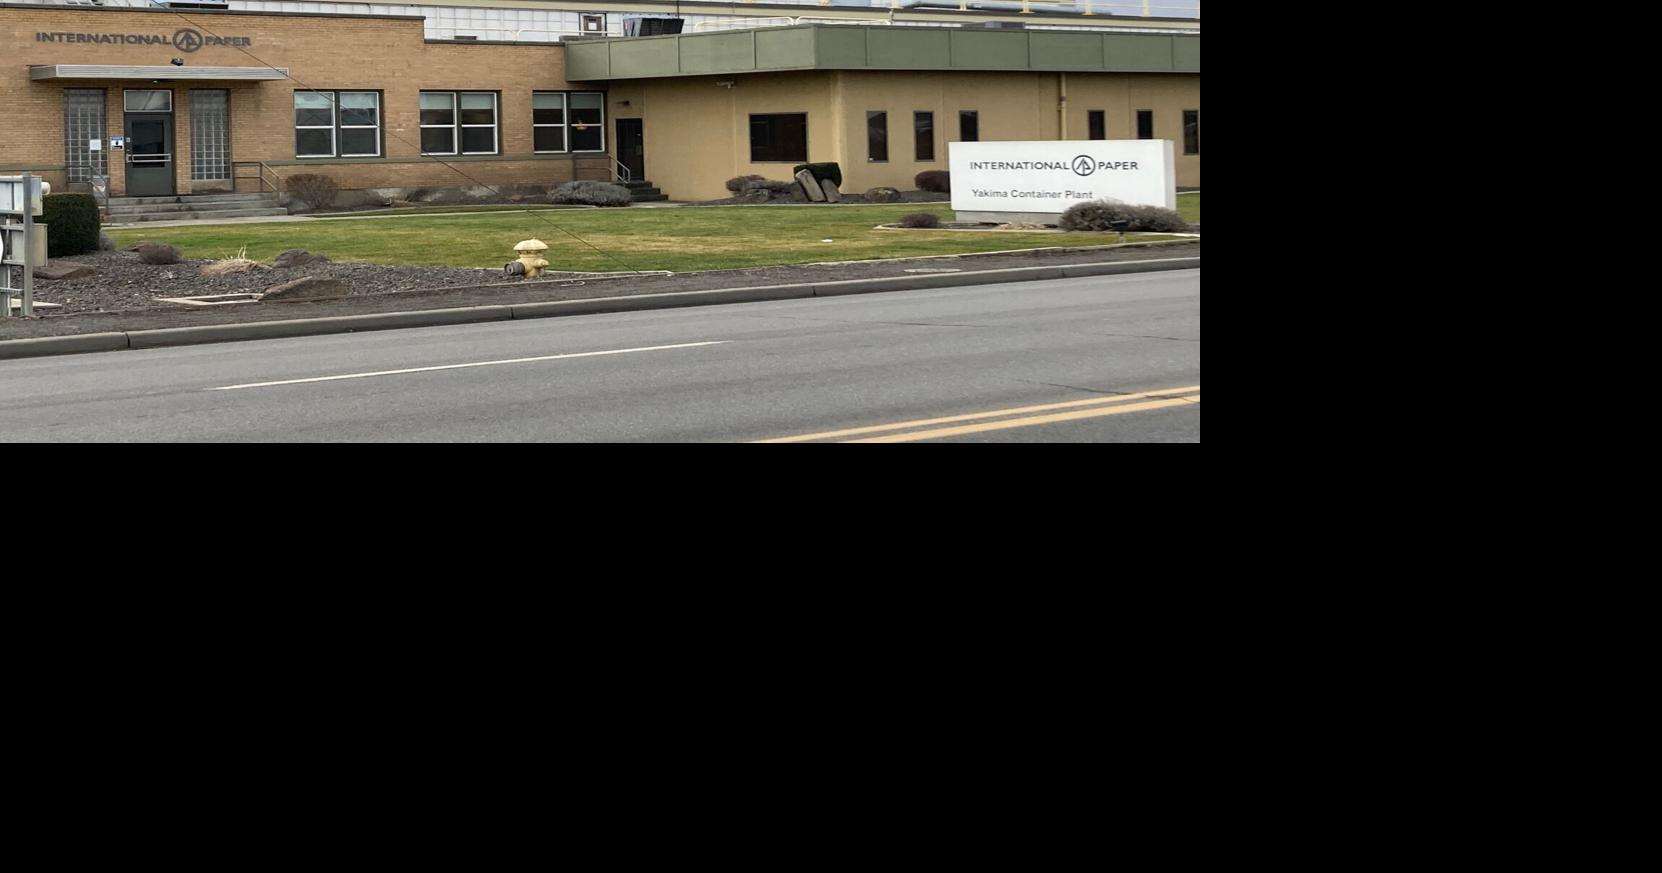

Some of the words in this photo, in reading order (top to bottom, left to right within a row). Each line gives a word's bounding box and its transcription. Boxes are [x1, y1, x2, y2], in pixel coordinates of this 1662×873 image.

[36, 32, 171, 46] INTERNATIONAL
[205, 36, 251, 46] PAPER
[970, 161, 1070, 170] INTERNATIONAL
[1098, 161, 1139, 170] PAPER
[972, 189, 1008, 198] Yakima
[1011, 190, 1062, 199] Container
[1065, 190, 1093, 199] Plant
